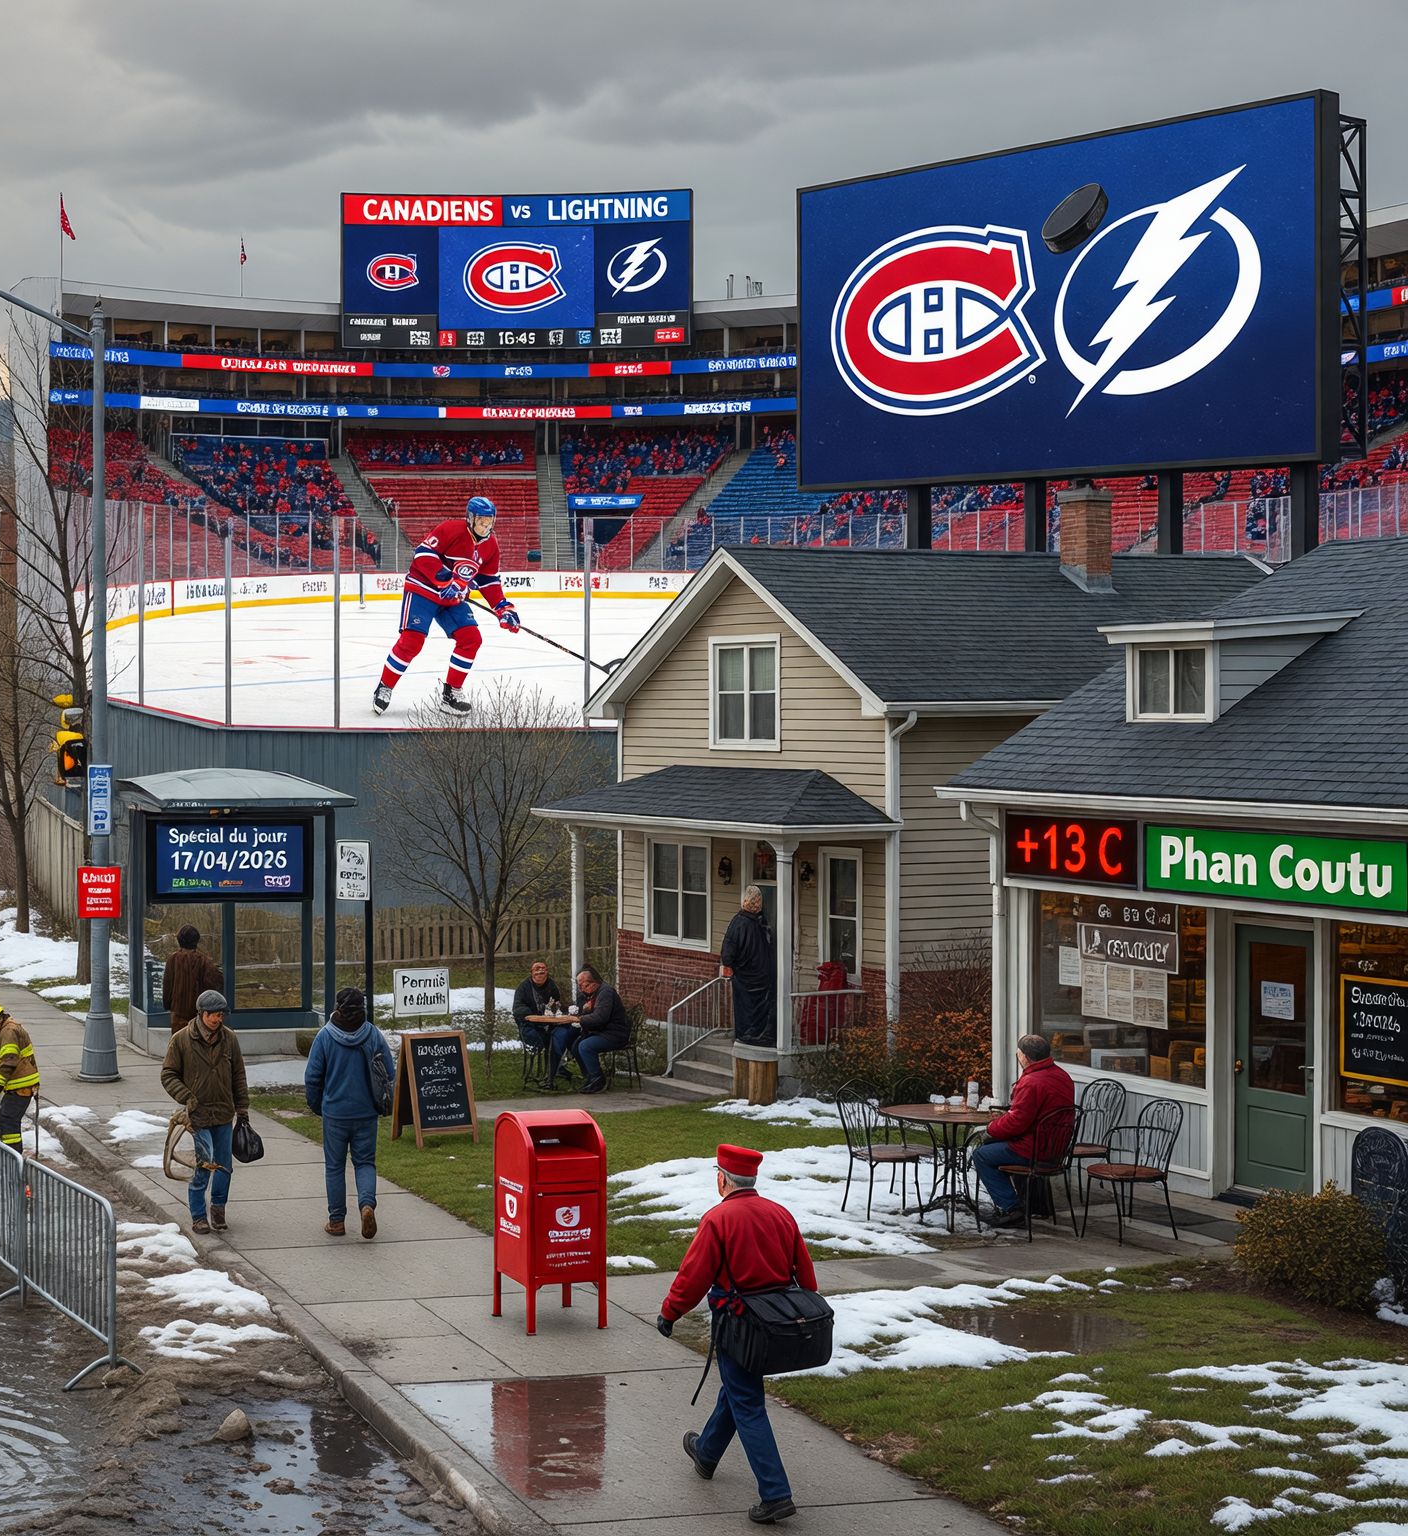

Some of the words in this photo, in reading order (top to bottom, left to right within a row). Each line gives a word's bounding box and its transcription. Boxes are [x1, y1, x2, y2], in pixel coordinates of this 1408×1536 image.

[363, 199, 494, 222] CANADIENS
[547, 197, 669, 221] LIGHTNING
[229, 827, 247, 843] du
[171, 849, 288, 873] 17/04/2026
[1017, 824, 1086, 873] +13
[1098, 827, 1123, 876] C
[1160, 834, 1258, 887] Phan
[1269, 844, 1393, 898] Coutu
